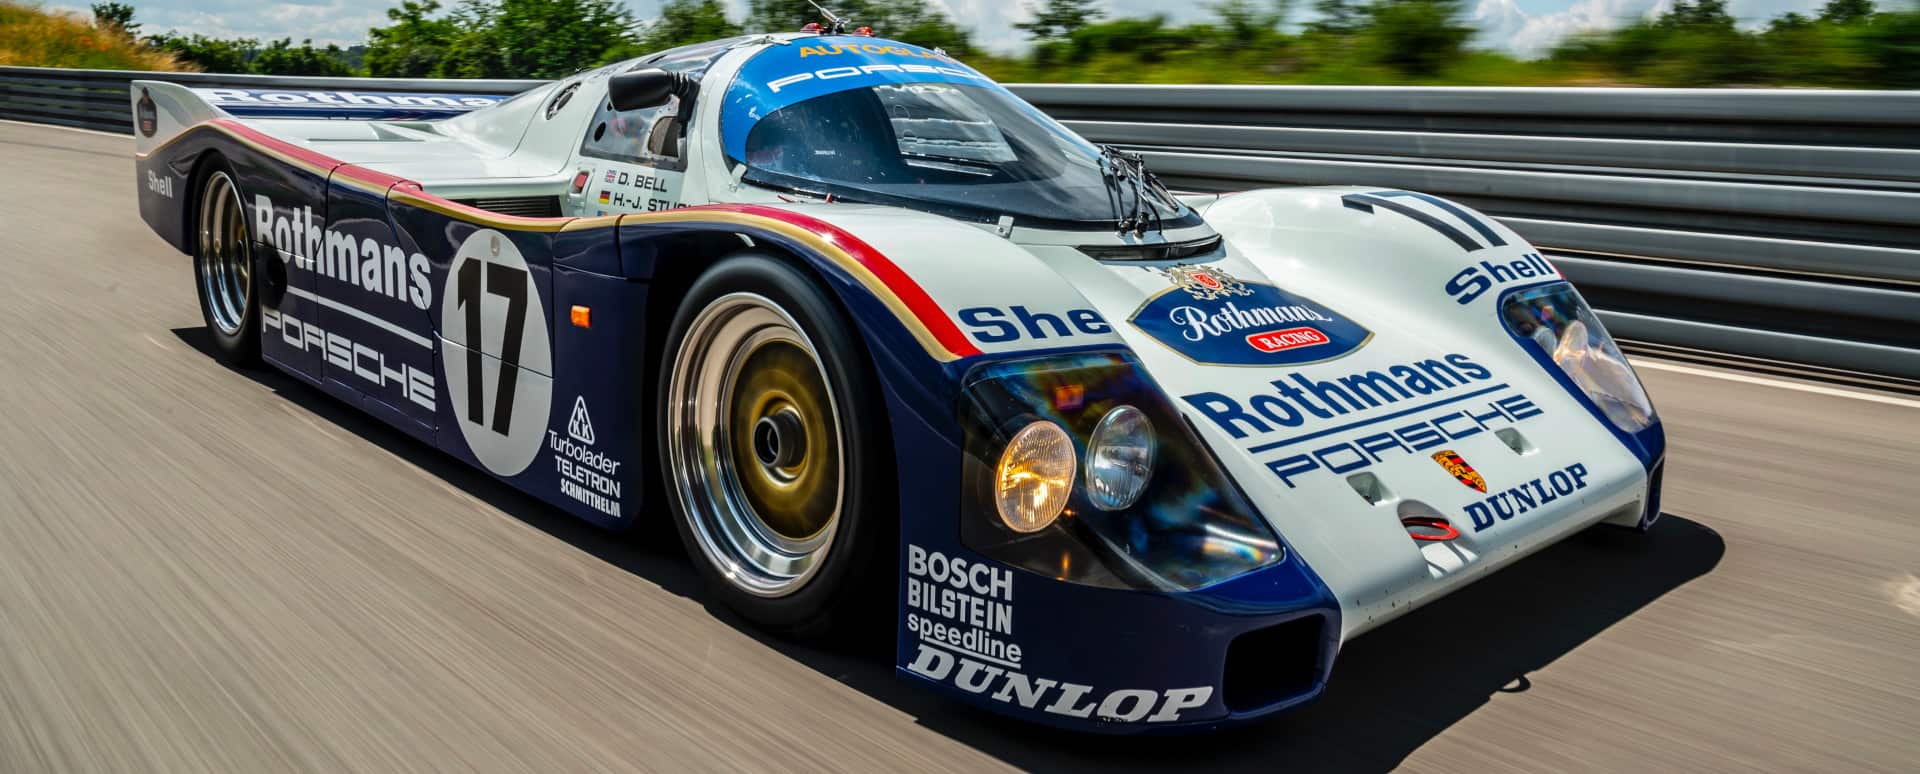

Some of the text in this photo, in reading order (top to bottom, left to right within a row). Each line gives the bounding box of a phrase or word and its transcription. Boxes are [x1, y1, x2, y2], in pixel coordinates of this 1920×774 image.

[207, 89, 504, 106] Rothma
[148, 169, 173, 198] Shell
[613, 192, 643, 210] H.-J.
[617, 172, 667, 193] D. BELL
[255, 194, 433, 311] Rothmans
[1445, 253, 1555, 305] Shell
[457, 256, 529, 437] 17
[1169, 301, 1333, 342] Rothmans
[1257, 330, 1322, 350] RACING
[262, 309, 437, 412] PORSCHE
[1180, 353, 1492, 439] Rothmans
[548, 428, 621, 475] Turbolader
[1264, 394, 1544, 488] PORSCHE
[555, 455, 621, 499] TELETRON
[560, 478, 621, 518] SCHMITTHELM
[1463, 462, 1588, 533] DUNLOP
[908, 543, 1013, 602] BOSCH
[907, 576, 1013, 635] BILSTEIN
[907, 612, 1022, 662] speedline
[906, 643, 1214, 723] DUNLOP
